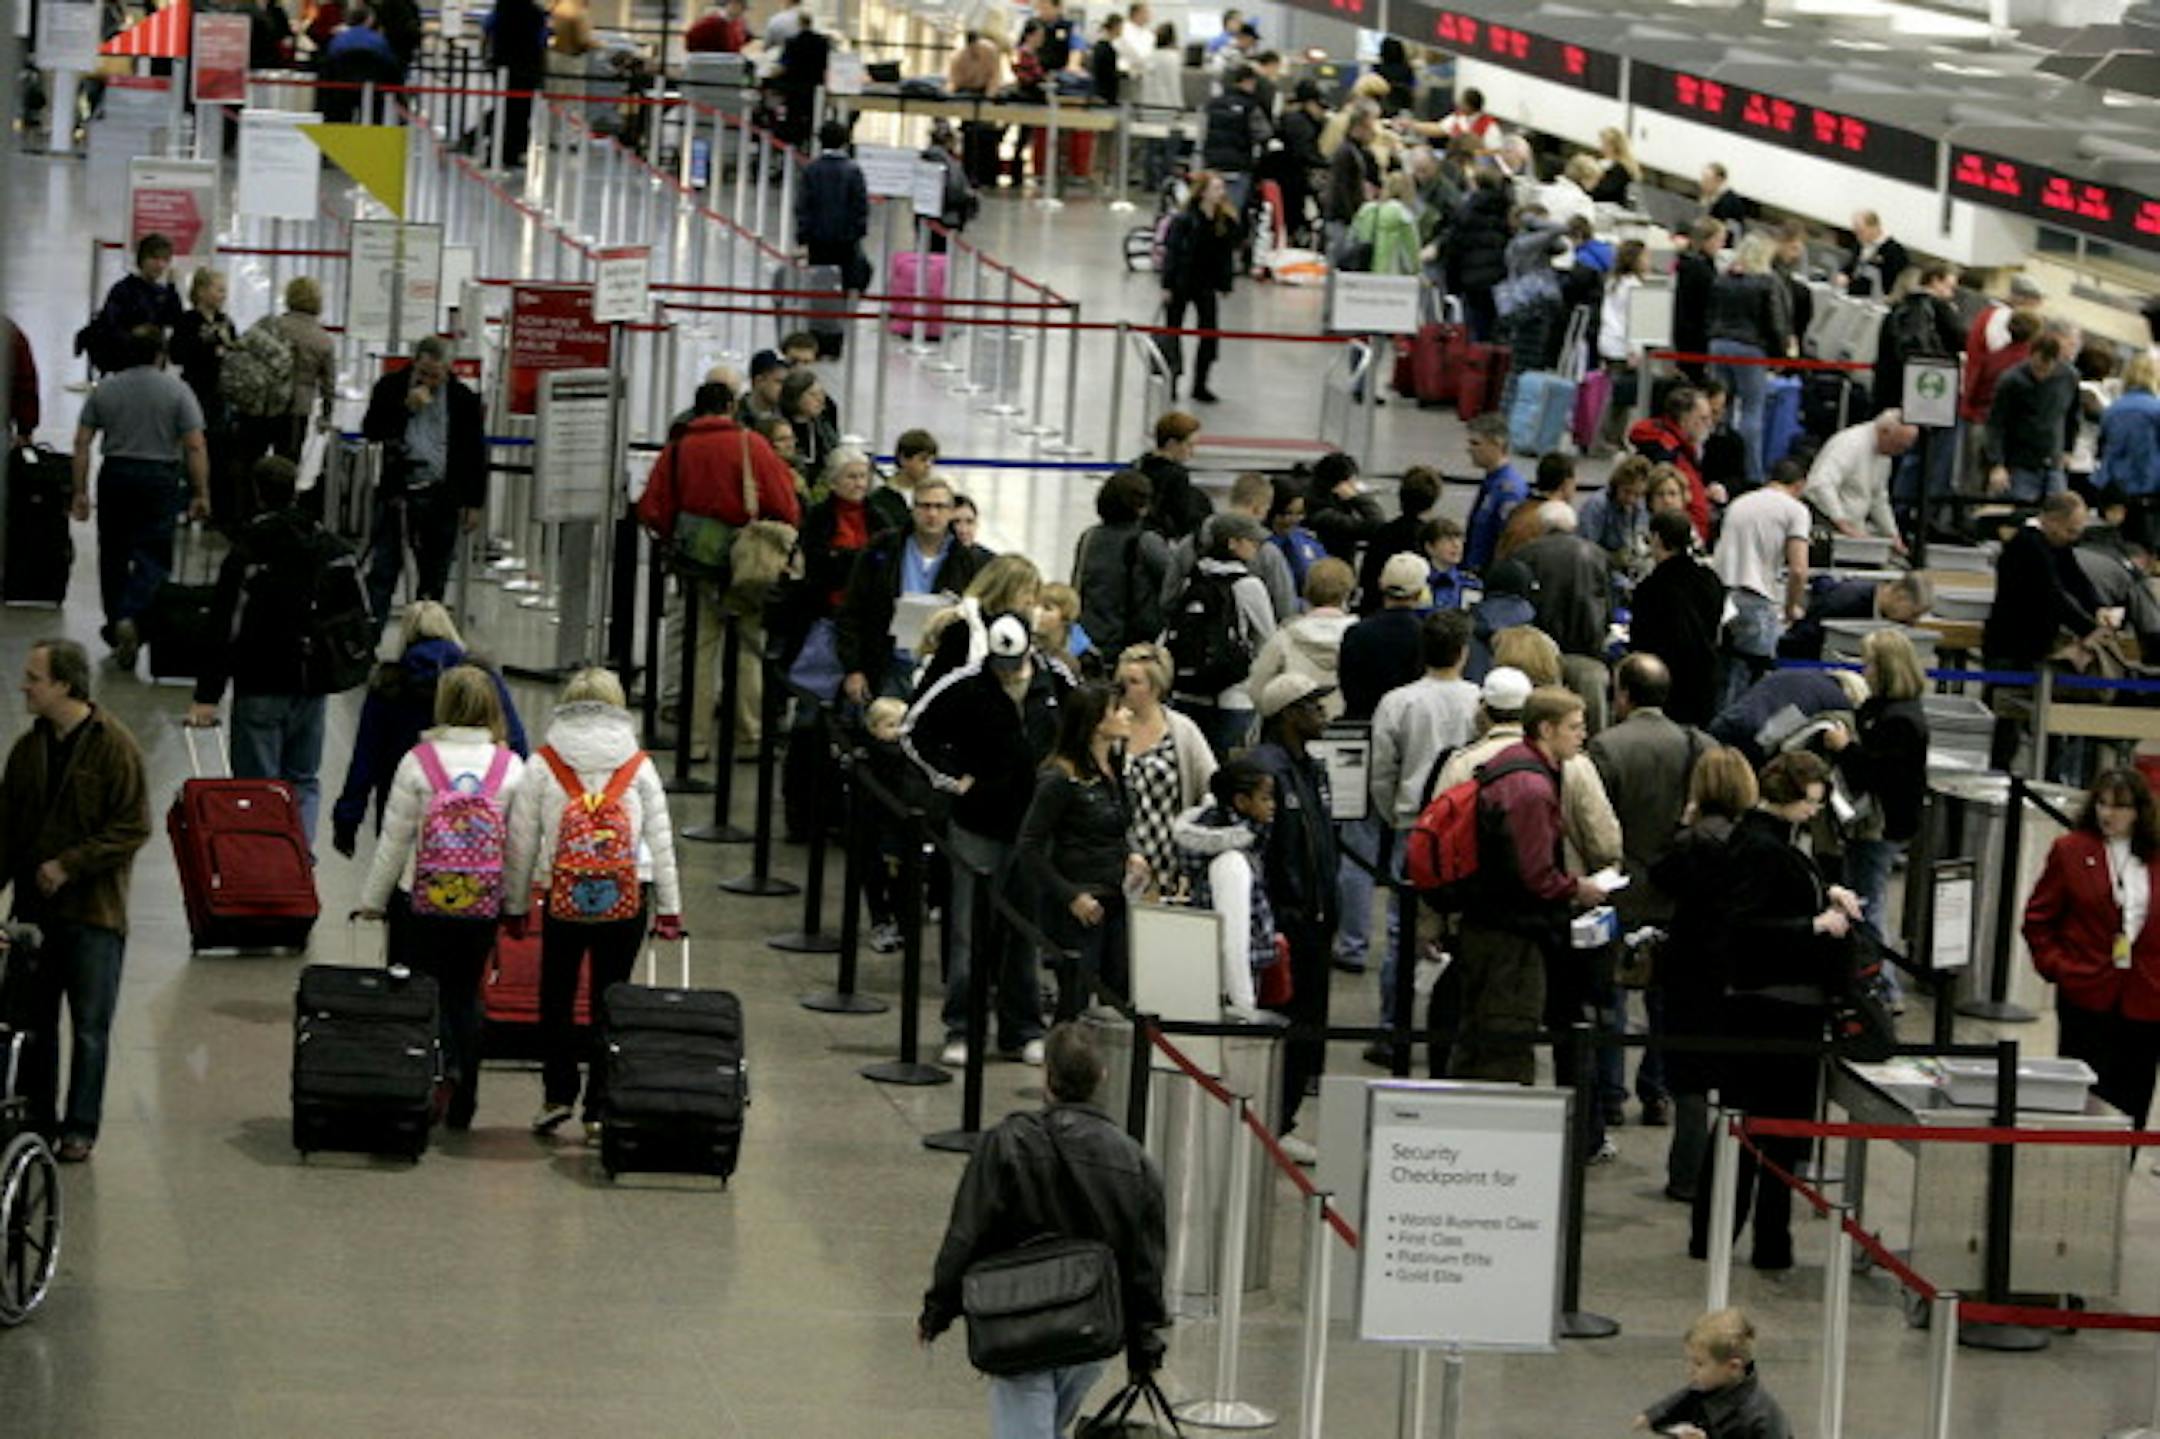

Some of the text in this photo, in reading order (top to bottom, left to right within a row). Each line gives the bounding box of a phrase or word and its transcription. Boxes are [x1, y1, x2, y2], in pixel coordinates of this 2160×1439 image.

[1392, 1143, 1460, 1165] Security
[1391, 1166, 1518, 1187] Checkpoint for
[1399, 1213, 1541, 1231] World Business Class
[1398, 1232, 1463, 1247] First Class
[1398, 1251, 1492, 1268] Platinum Elite
[1396, 1269, 1463, 1284] Gold Elite
